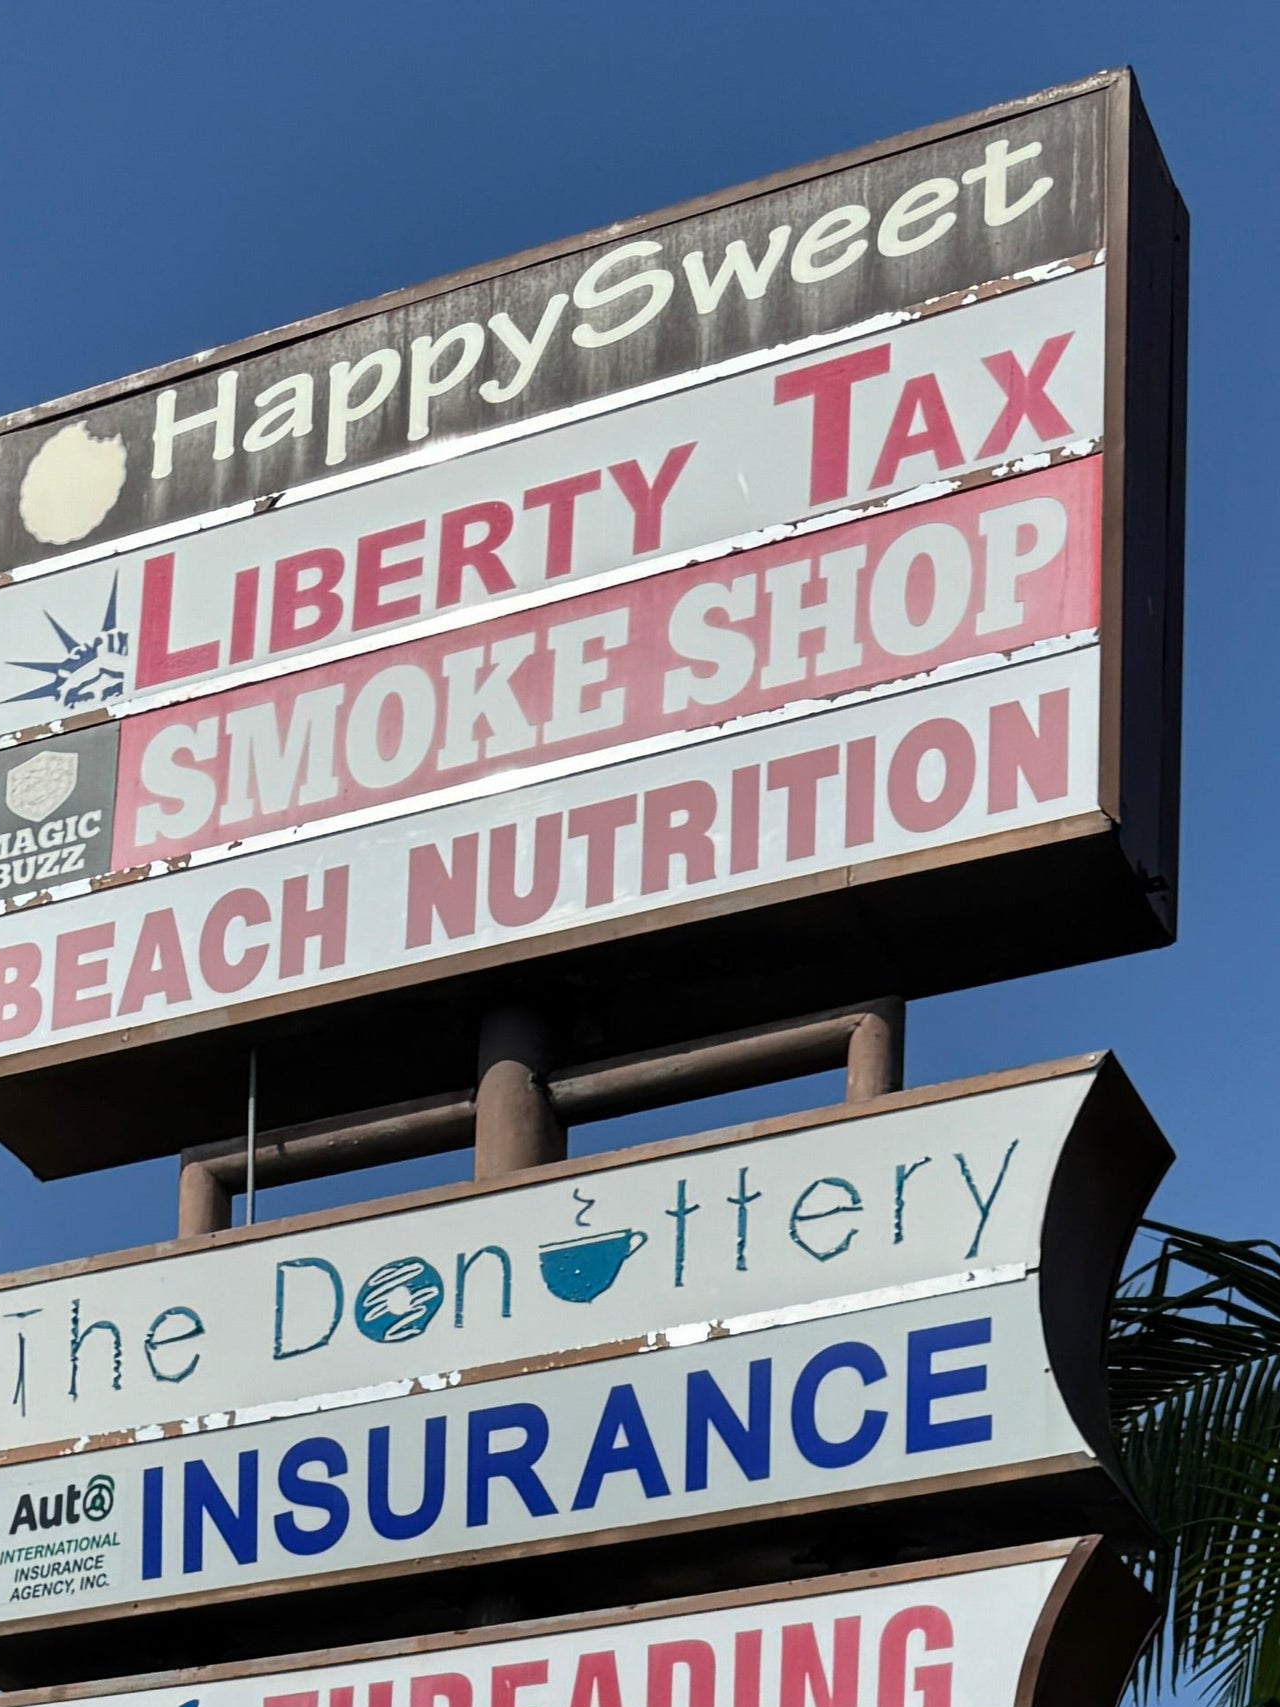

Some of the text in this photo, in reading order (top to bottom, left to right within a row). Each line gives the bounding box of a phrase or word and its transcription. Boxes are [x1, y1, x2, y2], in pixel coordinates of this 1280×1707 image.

[148, 139, 1056, 479] HappySweet
[133, 331, 1076, 690] LIBERTY TAX
[131, 497, 1068, 849] SMOKE SHOP
[404, 687, 1073, 951] NUTRITION
[1, 1298, 206, 1418] The
[141, 1316, 992, 1582] INSURANCE
[0, 1532, 121, 1565] INTERNATIONAL
[9, 1573, 110, 1602] AGENCY, INC.
[14, 1555, 105, 1583] INSURANCE
